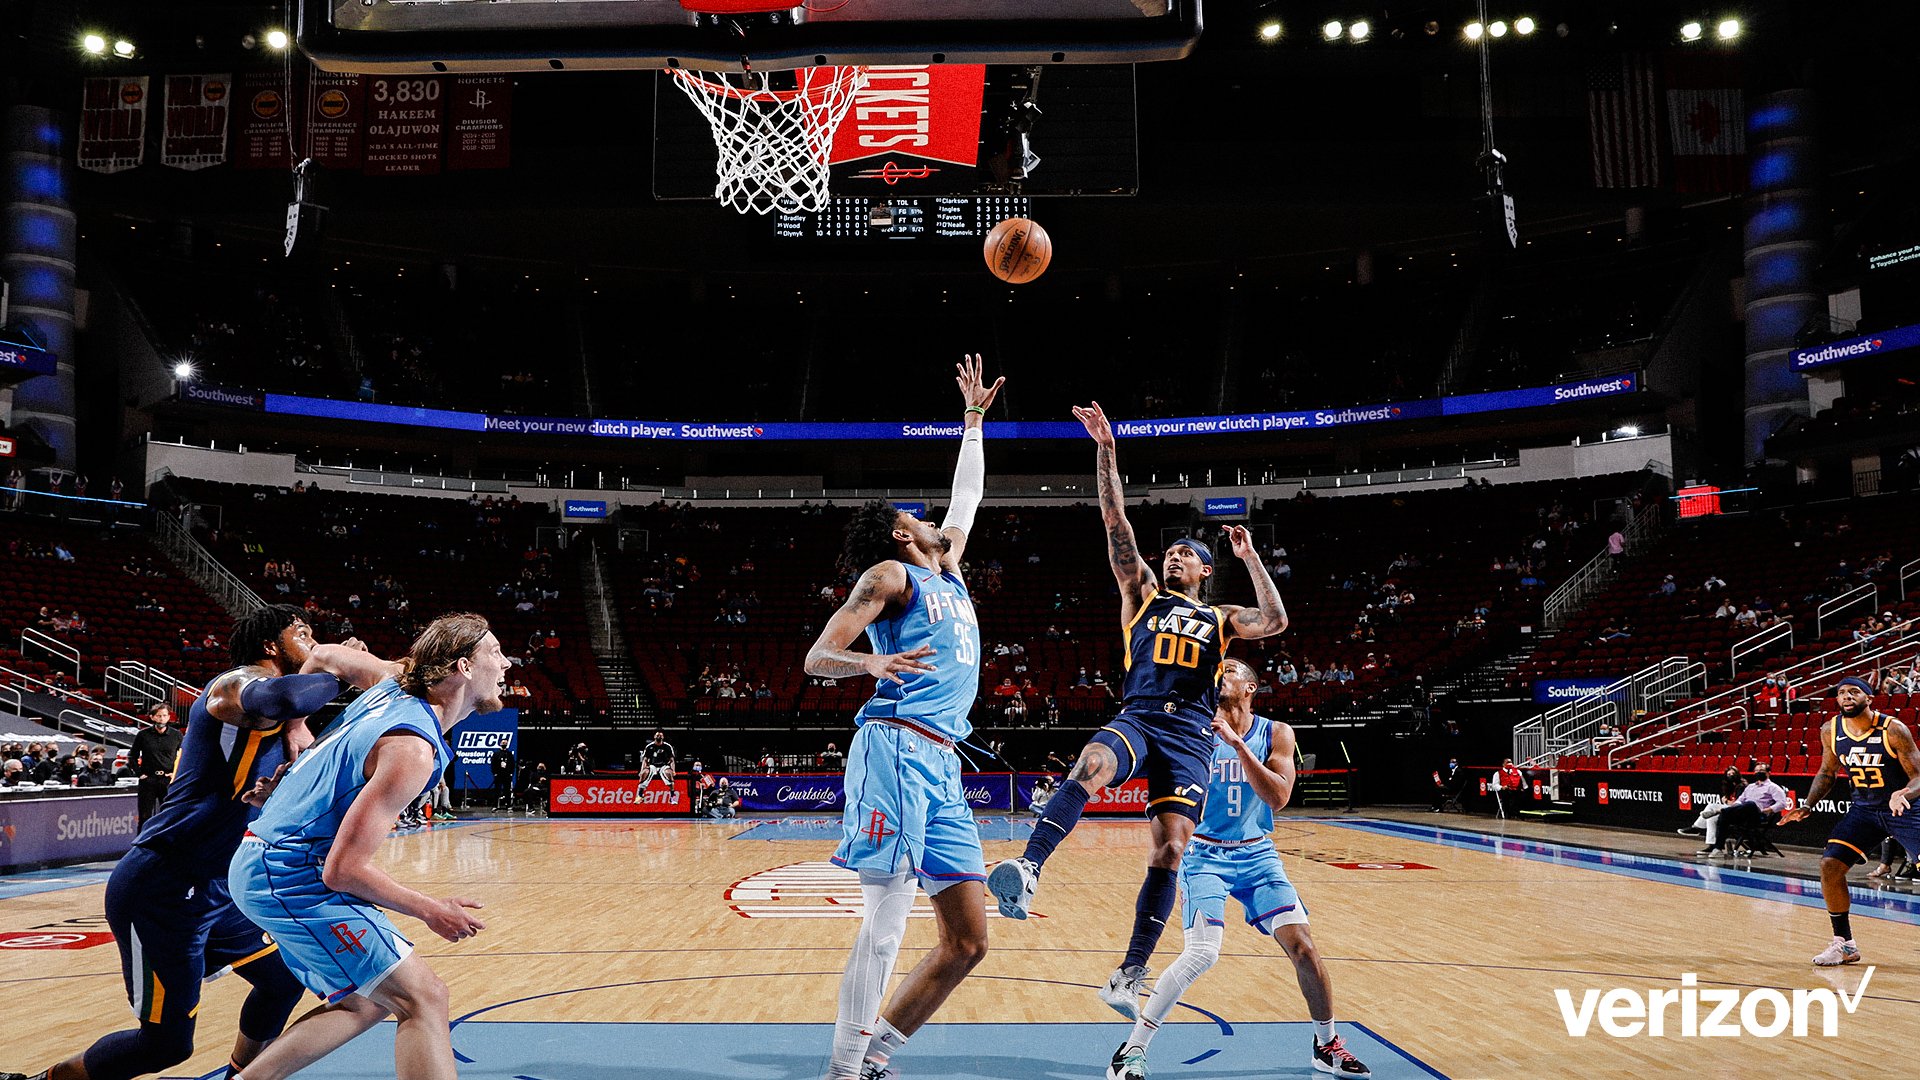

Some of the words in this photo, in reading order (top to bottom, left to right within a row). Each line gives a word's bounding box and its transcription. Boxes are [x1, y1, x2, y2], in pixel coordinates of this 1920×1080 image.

[373, 79, 440, 106] 3,830
[378, 110, 437, 120] HAKEEM
[369, 125, 440, 137] OLAJUWON
[368, 153, 408, 161] BLOCKED
[385, 164, 420, 172] LEADER
[1000, 229, 1027, 274] SPALDING
[1869, 251, 1898, 263] Enhance
[1876, 258, 1899, 268] Toyota
[1797, 339, 1873, 366] Southwest
[188, 385, 255, 406] Southwest
[1555, 379, 1623, 400] Southwest
[484, 417, 521, 430] Meet
[522, 421, 555, 434] your
[556, 422, 587, 433] new
[588, 421, 629, 435] clutch
[630, 423, 676, 439] player.
[681, 424, 754, 438] Southwest
[902, 425, 965, 436] Southwest
[1117, 423, 1152, 435] Meet
[1153, 422, 1186, 437] your
[1187, 420, 1217, 432] new
[1218, 417, 1260, 430] clutch
[1262, 415, 1309, 431] player.
[1315, 407, 1391, 425] Southwest
[1147, 606, 1216, 643] JAZZ
[954, 622, 976, 667] 35
[1152, 632, 1201, 669] 00
[1547, 685, 1606, 698] Southwest
[462, 757, 487, 765] Credit
[1839, 746, 1885, 767] JAZZ
[1850, 767, 1885, 788] 23
[585, 786, 634, 805] State
[776, 785, 838, 805] Courtside
[1103, 785, 1150, 804] State
[1227, 785, 1242, 817] 9
[1608, 787, 1633, 800] TOYOTA
[1633, 788, 1663, 802] CENTER
[1692, 792, 1721, 805] TOYOTA
[57, 810, 134, 841] Southwest
